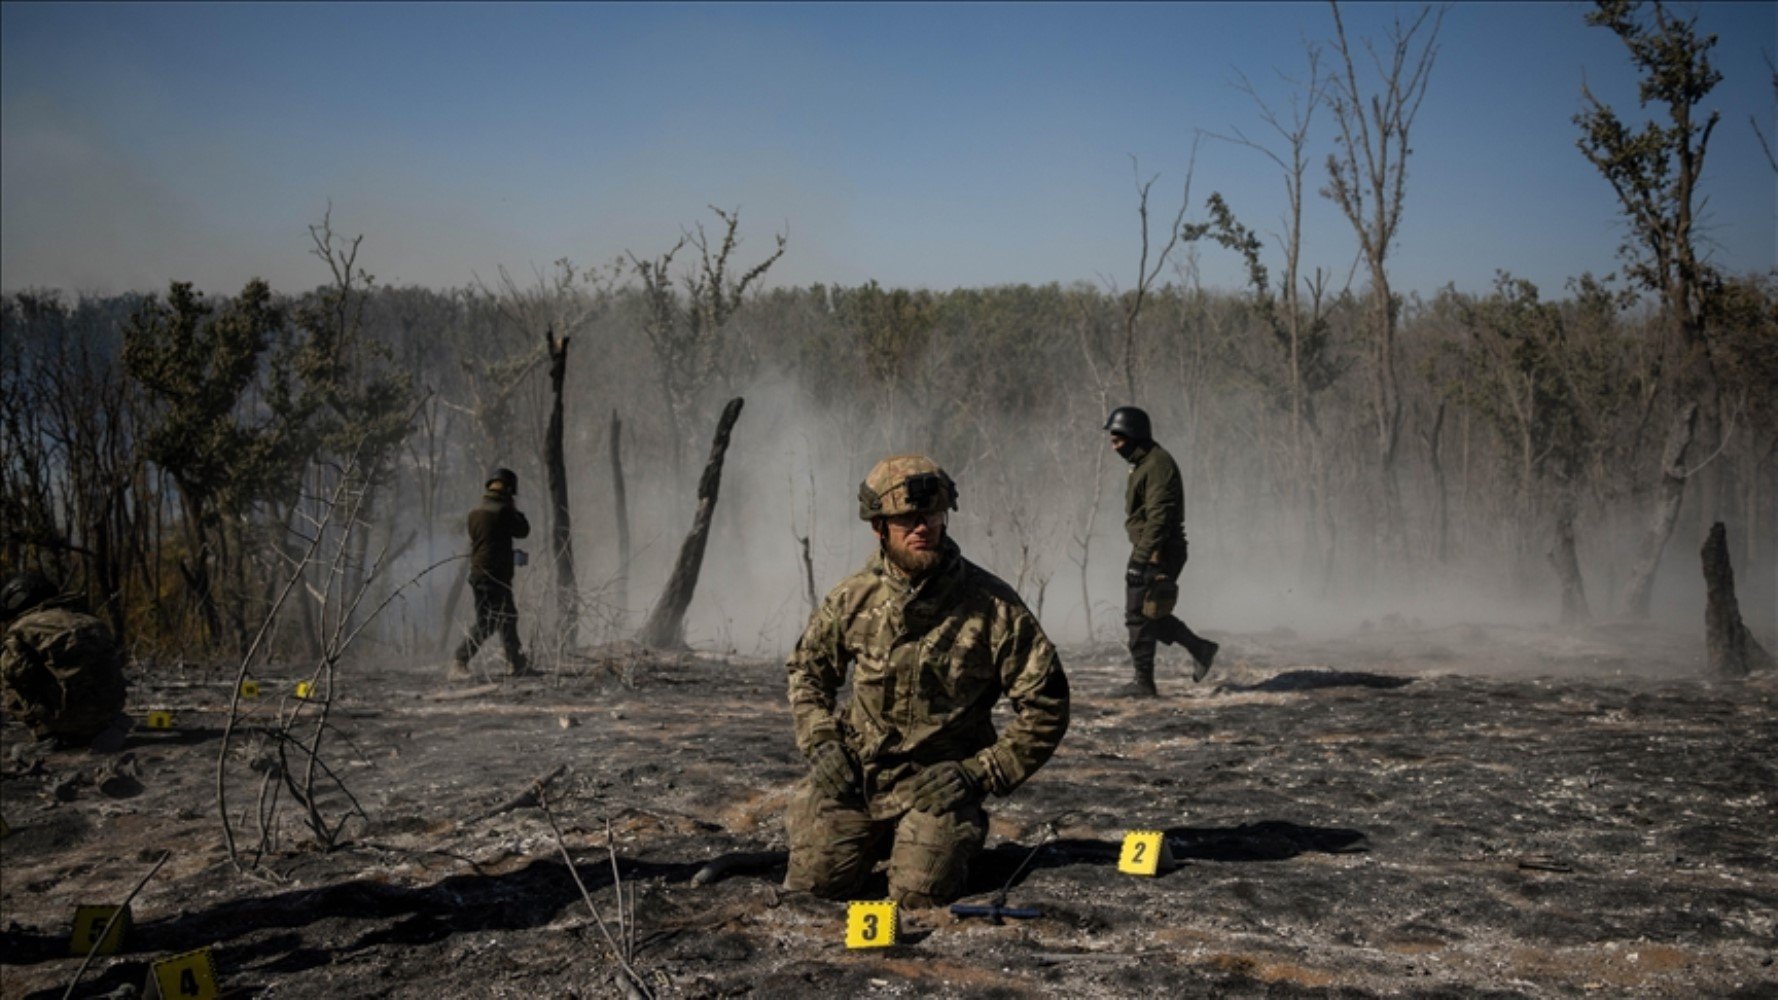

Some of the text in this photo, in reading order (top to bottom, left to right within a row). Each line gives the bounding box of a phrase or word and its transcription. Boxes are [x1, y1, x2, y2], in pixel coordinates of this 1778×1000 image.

[1132, 842, 1147, 864] 2
[861, 913, 879, 941] 3
[179, 968, 199, 997] 4
